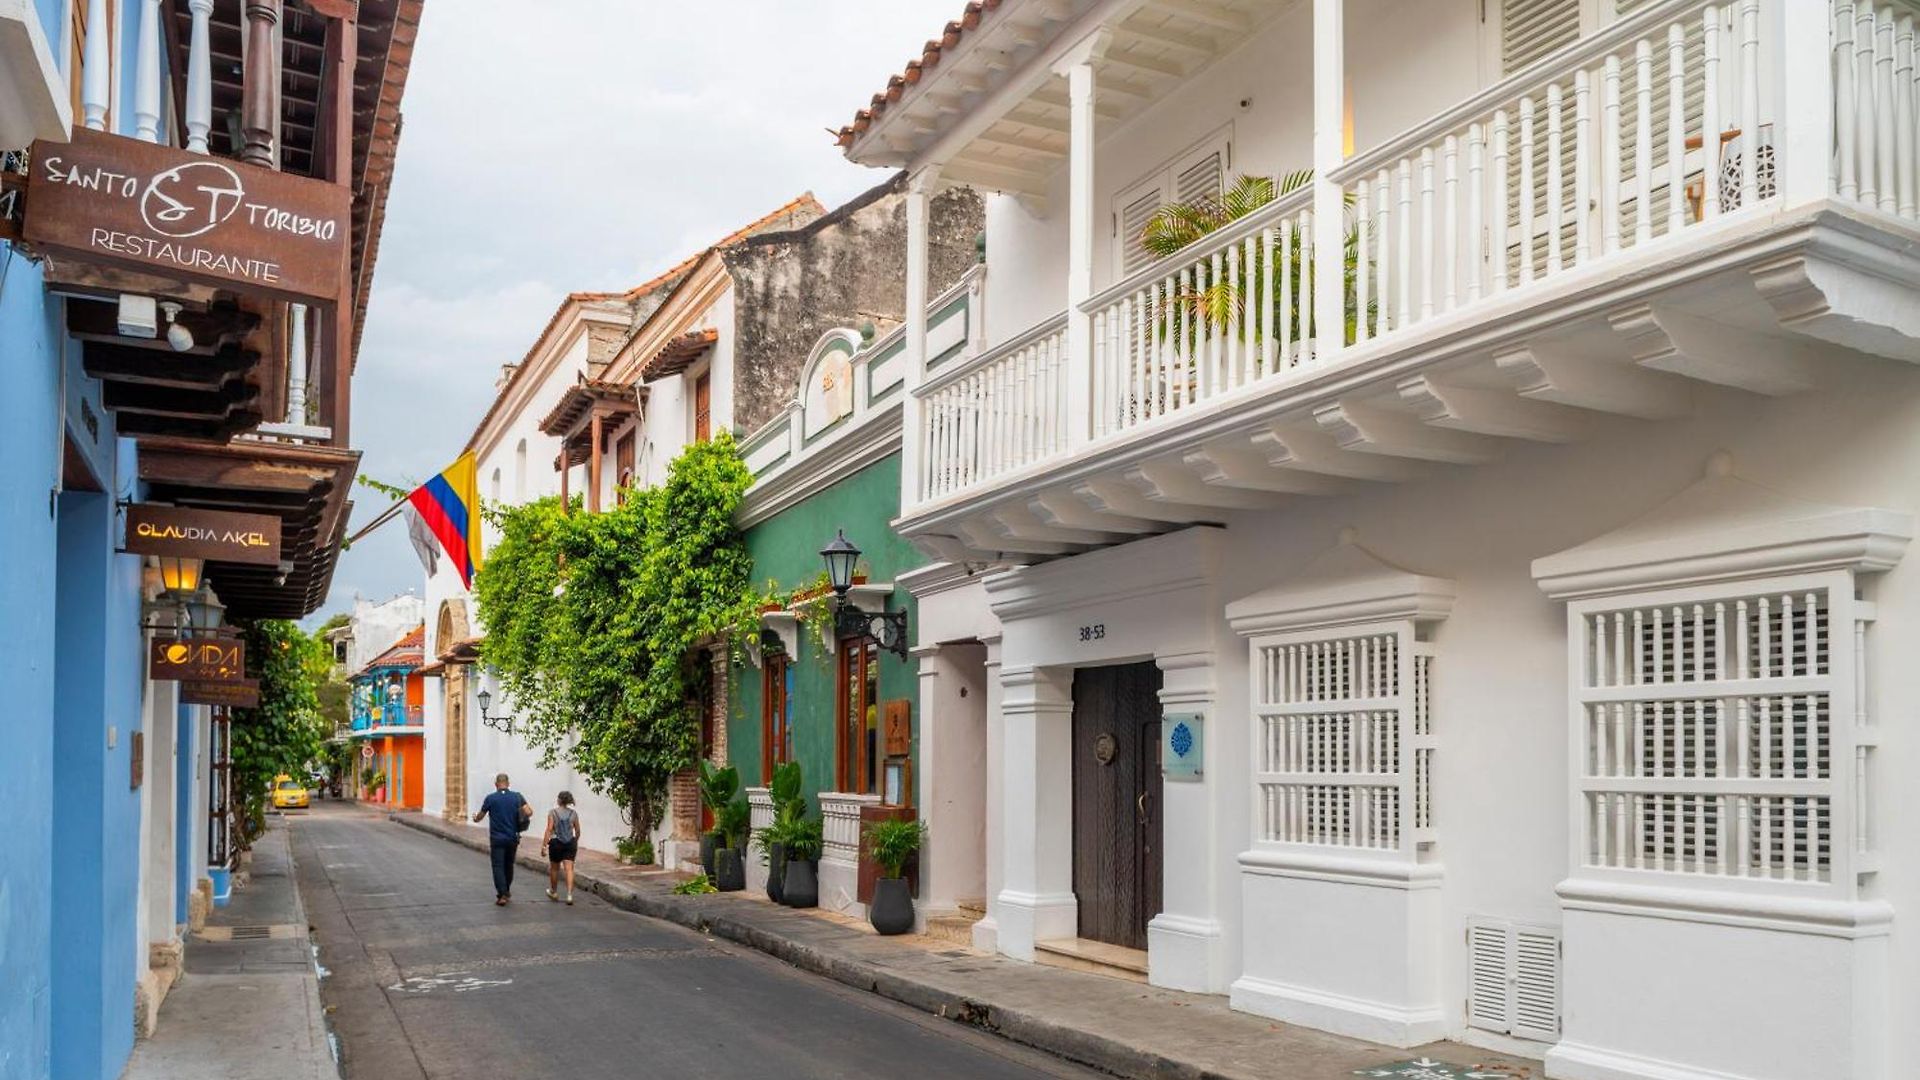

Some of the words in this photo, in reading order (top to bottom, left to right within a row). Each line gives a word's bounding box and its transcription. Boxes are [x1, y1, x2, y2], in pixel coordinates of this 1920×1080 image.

[45, 157, 137, 197] SANTO
[246, 203, 335, 240] TORIBIO
[92, 227, 280, 283] RESTAURANTE
[137, 522, 218, 542] CLAUDIA
[222, 530, 270, 547] AKEL
